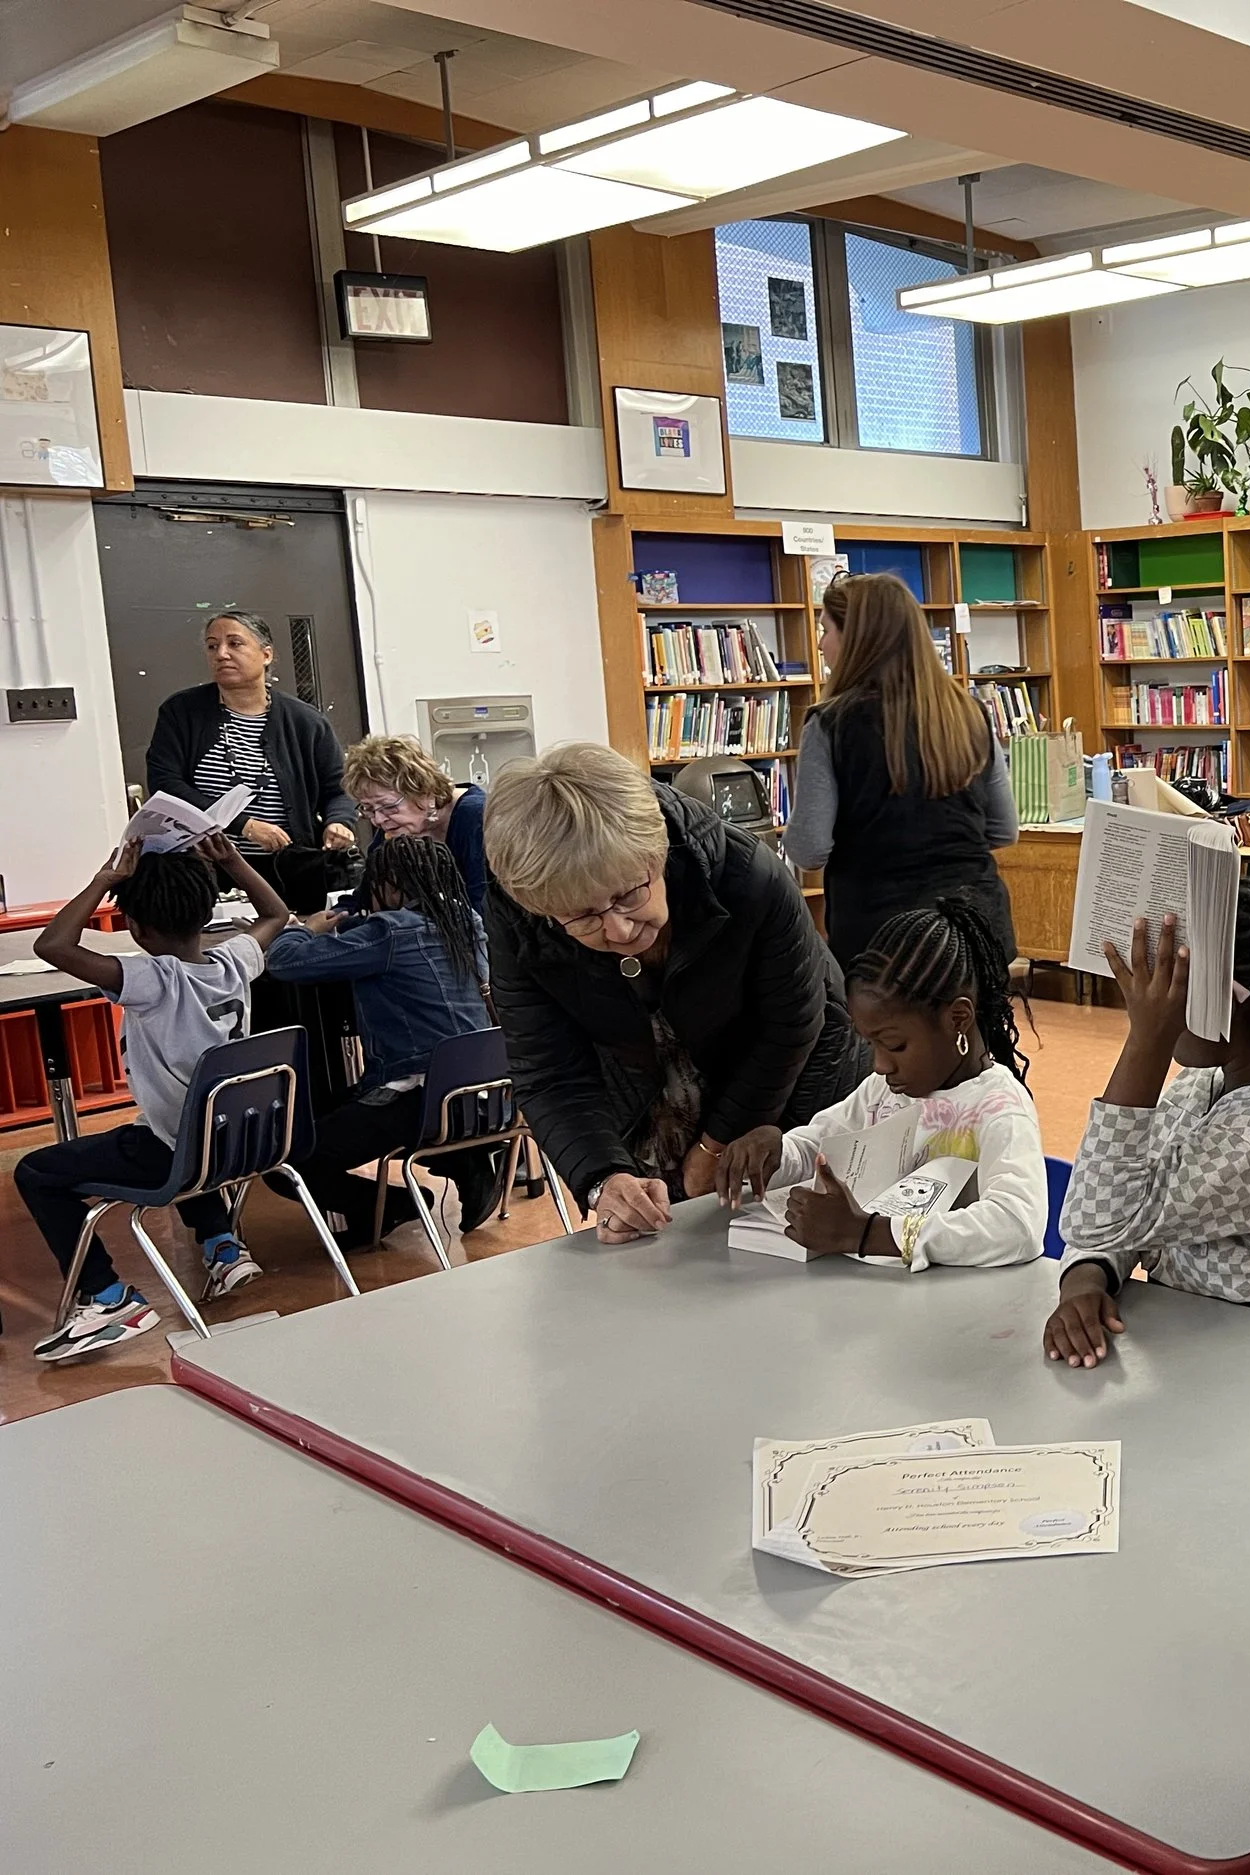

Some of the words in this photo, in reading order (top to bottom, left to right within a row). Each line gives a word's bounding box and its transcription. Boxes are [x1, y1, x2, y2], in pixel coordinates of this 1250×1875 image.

[353, 287, 418, 333] EXIT
[902, 1471, 946, 1481] Perfect
[950, 1466, 1022, 1478] Attendance
[881, 1526, 930, 1534] Attending
